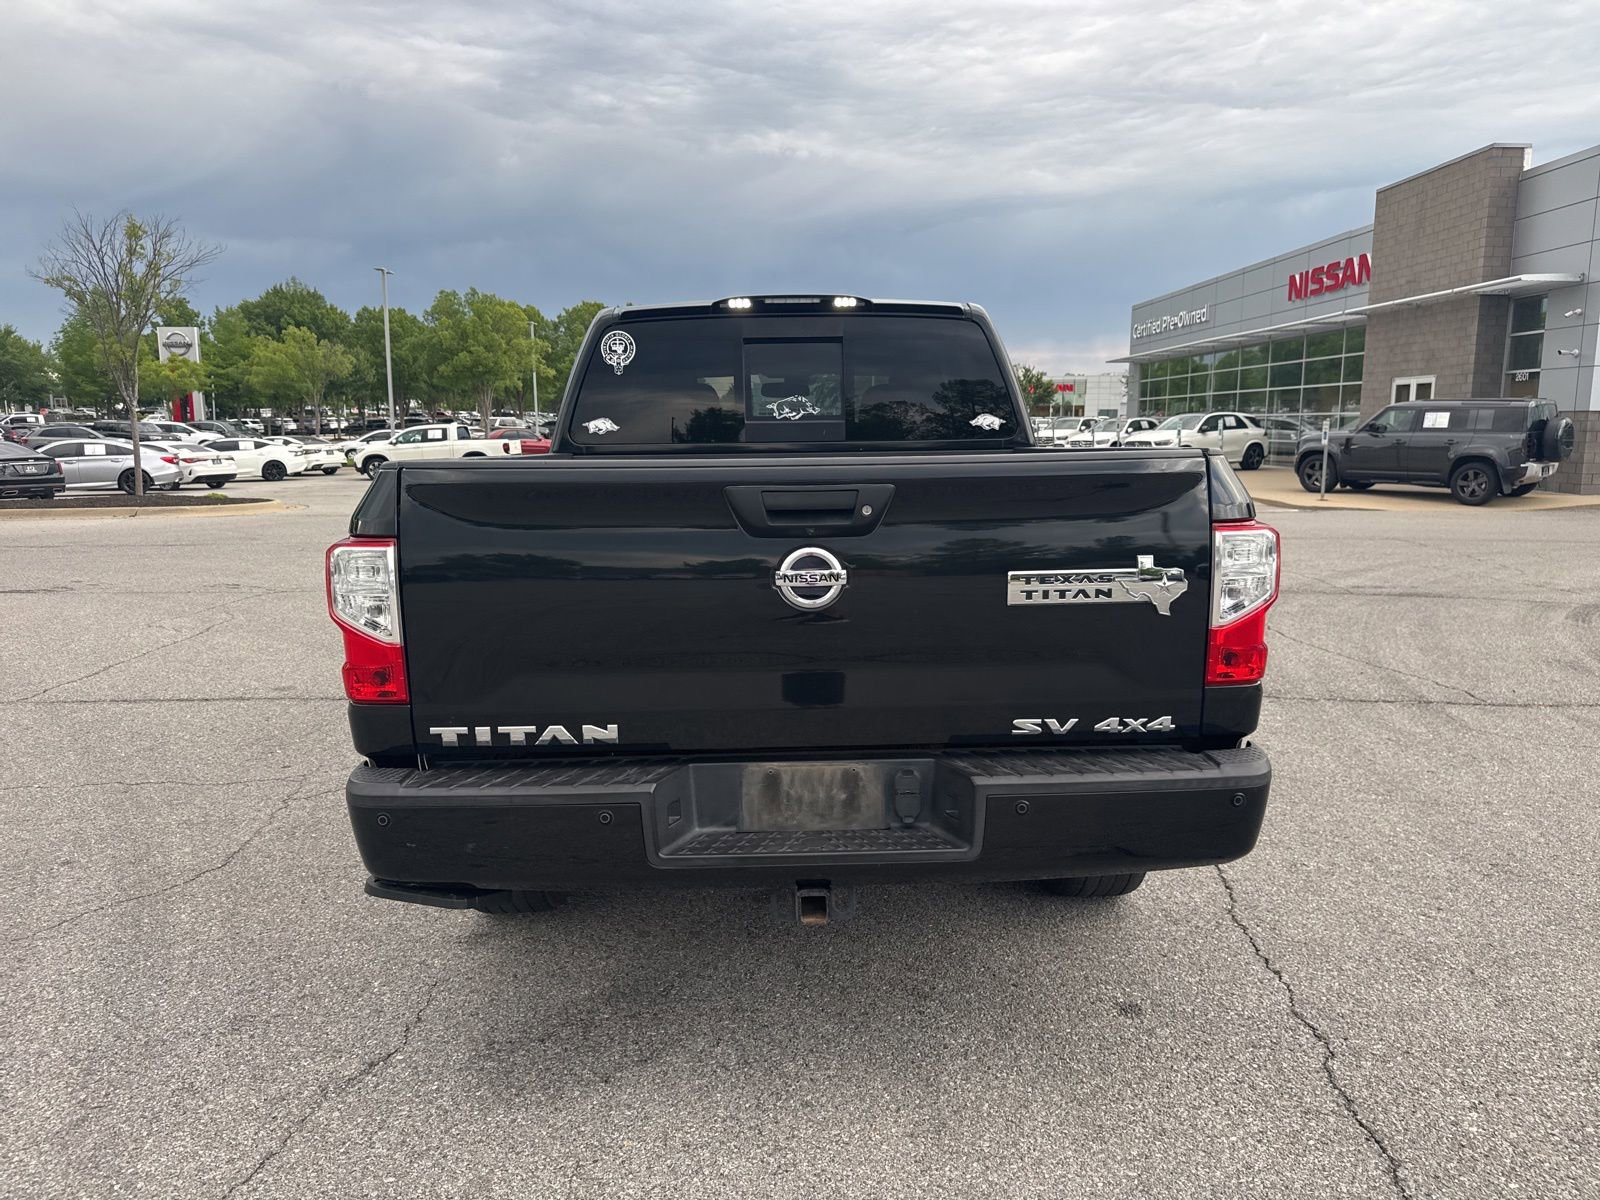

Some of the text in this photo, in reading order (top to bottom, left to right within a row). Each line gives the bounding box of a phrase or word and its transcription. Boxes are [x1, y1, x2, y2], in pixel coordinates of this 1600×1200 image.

[1288, 253, 1372, 302] NISSAN
[1133, 304, 1207, 339] Certified Pre-Owned
[783, 573, 840, 583] NISSAN
[1020, 574, 1114, 585] TEXAS
[1020, 588, 1113, 601] TITAN
[1011, 718, 1079, 735] SV
[429, 724, 619, 747] TITAN
